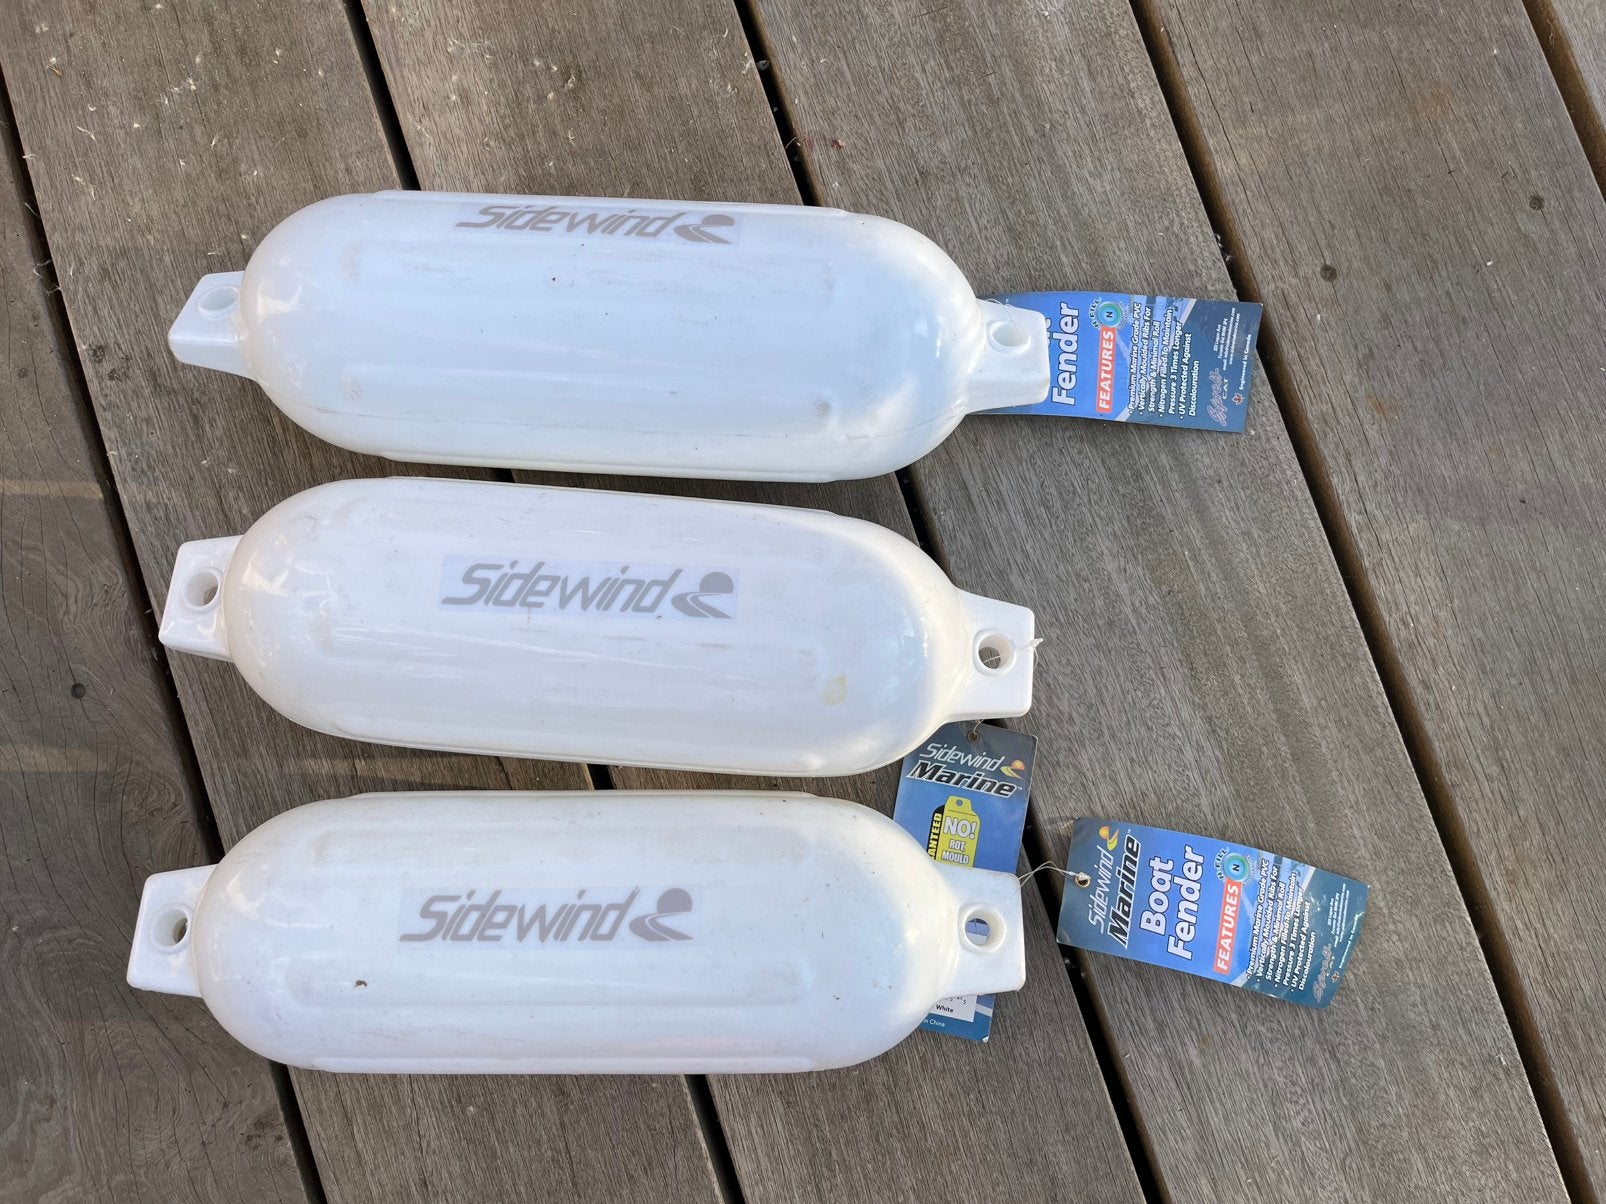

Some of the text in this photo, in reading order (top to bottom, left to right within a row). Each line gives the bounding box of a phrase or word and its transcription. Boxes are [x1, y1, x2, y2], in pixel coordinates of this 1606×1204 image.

[456, 204, 688, 237] Sidewind
[1142, 321, 1150, 338] Ribs
[1152, 321, 1160, 337] Roll
[1173, 321, 1182, 350] Longer
[1051, 302, 1079, 406] Fender
[1099, 330, 1115, 409] FEATURES
[1128, 302, 1141, 410] Premium Marine Grade PVC
[1140, 339, 1148, 374] Moulded
[1150, 338, 1159, 372] Minimal
[1158, 309, 1173, 413] Nitrogen Filled To Maintain
[1171, 351, 1179, 373] Times
[1179, 333, 1192, 415] UV Protected Against
[1138, 375, 1147, 410] Vertically
[1148, 379, 1157, 412] Strength
[1168, 382, 1177, 415] Pressure
[1189, 360, 1200, 417] Discolouration
[441, 559, 684, 613] Sidewind
[919, 743, 1006, 772] Sidewind
[927, 812, 943, 860] ANTEED
[944, 816, 977, 840] NO!
[941, 850, 970, 865] MOULD
[1088, 844, 1114, 934] Sidewind
[1140, 856, 1174, 936] Boat
[1167, 844, 1204, 960] Fender
[1278, 882, 1286, 899] Roll
[399, 886, 640, 942] Sidewind
[1217, 883, 1239, 971] FEATURES
[1247, 859, 1269, 974] Premium Marine Grade PVC
[1256, 865, 1279, 977] Vertically Moulded Ribs For
[1273, 900, 1284, 937] Minimal
[1274, 946, 1286, 983] Nitrogen
[1281, 922, 1290, 945] Filled
[1286, 872, 1297, 910] Maintain
[1282, 887, 1304, 986] Pressure 3 Times Longer
[1265, 945, 1277, 981] Strength
[1291, 901, 1311, 988] UV Protected Against
[1298, 931, 1316, 991] Discolouration
[929, 1018, 946, 1028] China
[936, 1003, 954, 1013] White
